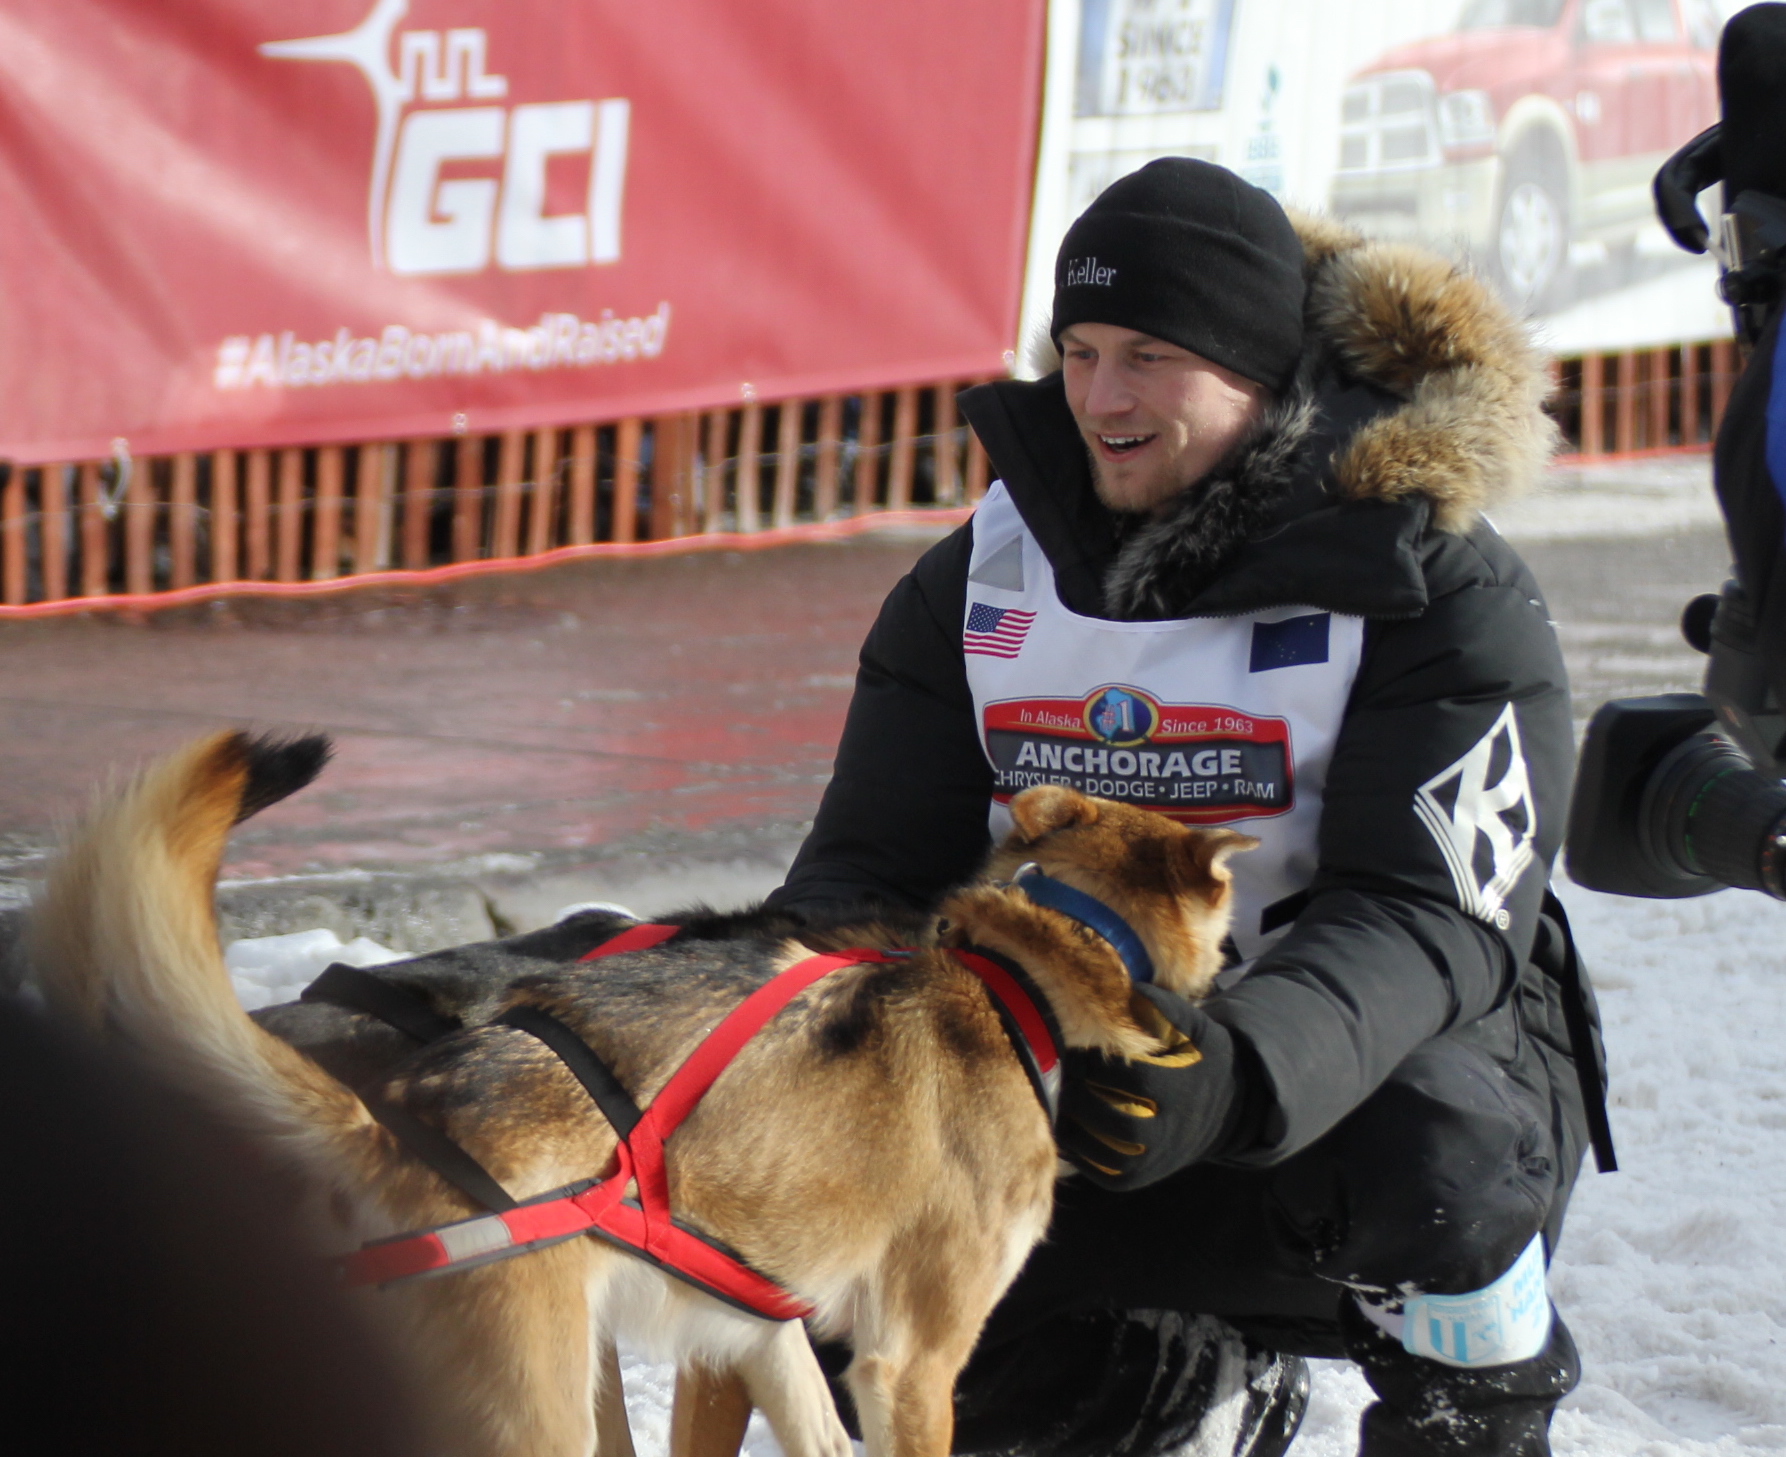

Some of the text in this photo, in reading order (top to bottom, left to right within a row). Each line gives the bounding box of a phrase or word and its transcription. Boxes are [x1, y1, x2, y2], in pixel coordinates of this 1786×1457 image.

[386, 97, 631, 278] GCI
[1066, 256, 1118, 287] Keller
[213, 300, 672, 391] #AlaskaBornAndRaised
[1019, 708, 1081, 728] In Alaska
[1161, 716, 1254, 734] Since 1963
[1015, 740, 1242, 779] ANCHORAGE
[1085, 777, 1156, 798] DODGE
[1169, 780, 1218, 799] JEEP
[1233, 778, 1275, 800] RAM
